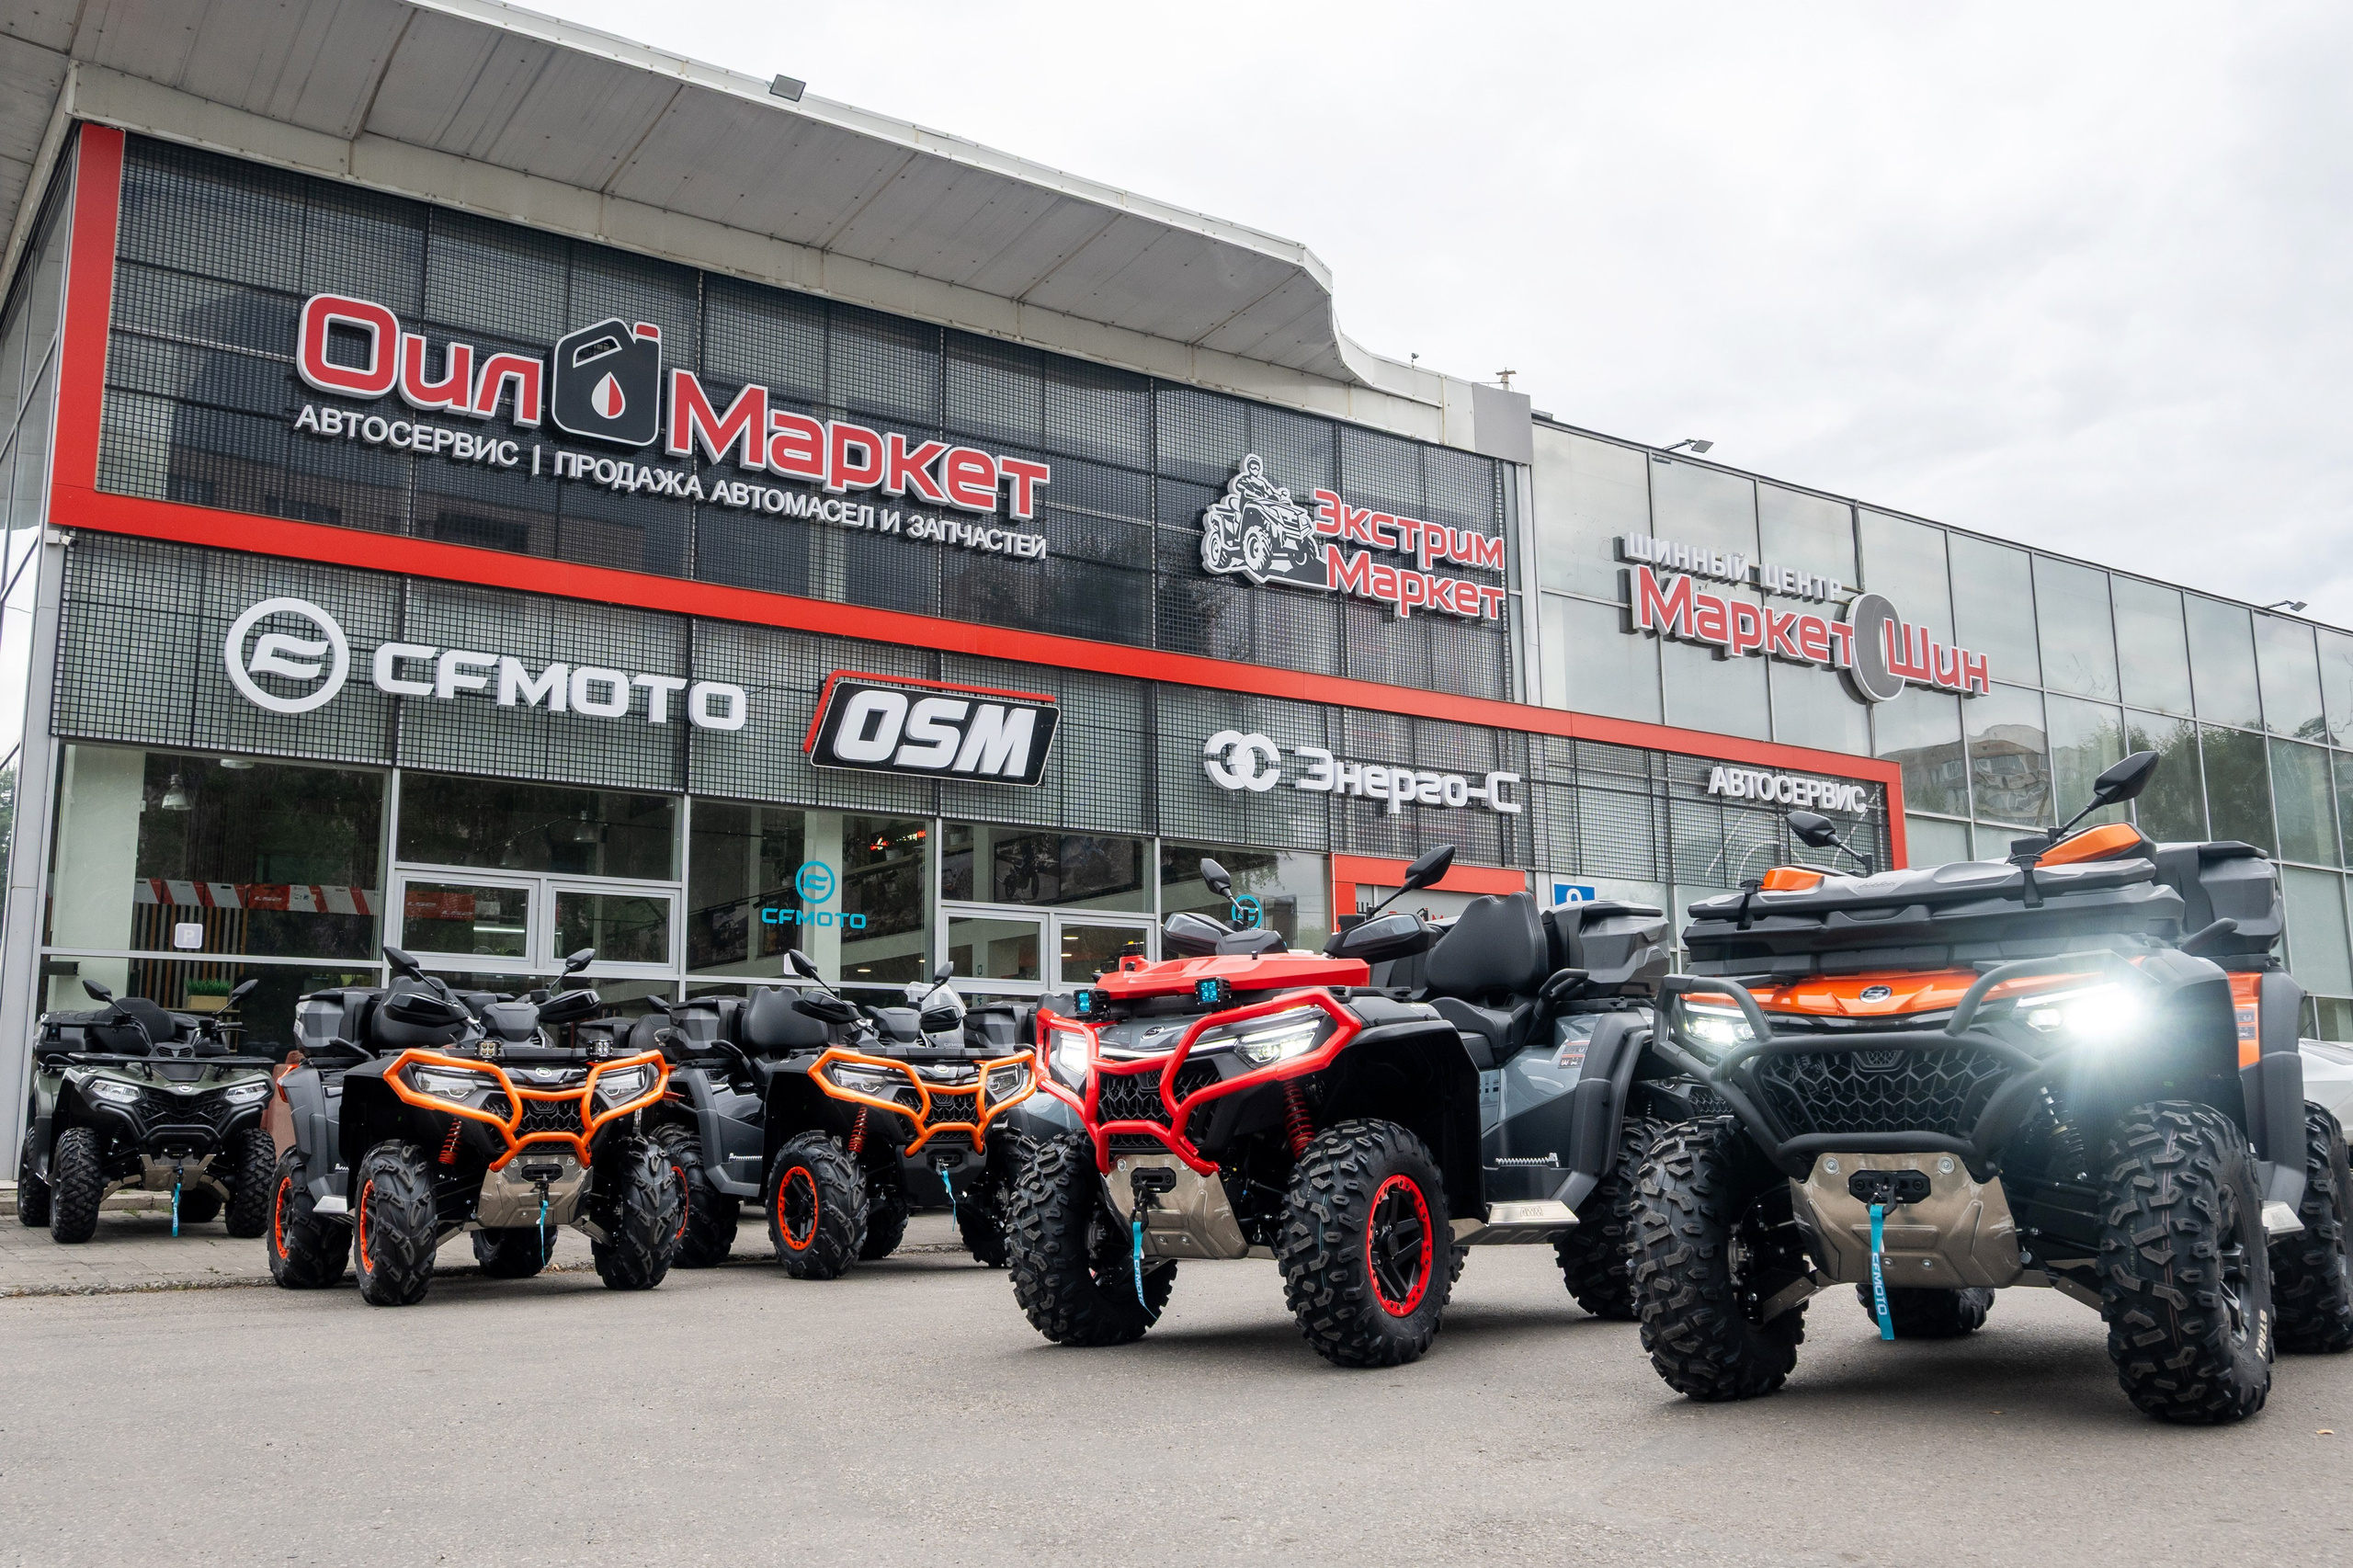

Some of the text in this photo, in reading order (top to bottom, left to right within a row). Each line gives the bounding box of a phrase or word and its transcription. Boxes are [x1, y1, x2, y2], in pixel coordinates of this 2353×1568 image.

[297, 293, 1051, 520] Оил Маркет
[294, 404, 518, 467] АВТОСЕРВИС
[554, 450, 704, 501] ПРОДАЖА
[710, 479, 874, 529] АВТОМАСЕЛ
[880, 509, 900, 534] И
[906, 515, 1047, 560] ЗАПЧАСТЕЙ
[1309, 488, 1505, 571] Экстрим
[1623, 531, 1842, 602] ШИННЫЙ ЦЕНТР
[1322, 543, 1506, 620] Маркет
[1630, 563, 1991, 697] Маркет Шин
[372, 642, 746, 731] CFMOTO
[834, 690, 1037, 778] OSM
[1294, 745, 1522, 814] Энерго-С
[1708, 766, 1868, 813] АВТОСЕРВИС
[761, 907, 867, 929] CFMOTO
[1134, 1259, 1145, 1306] CFMOTO
[1872, 1252, 1888, 1315] CFMOTO
